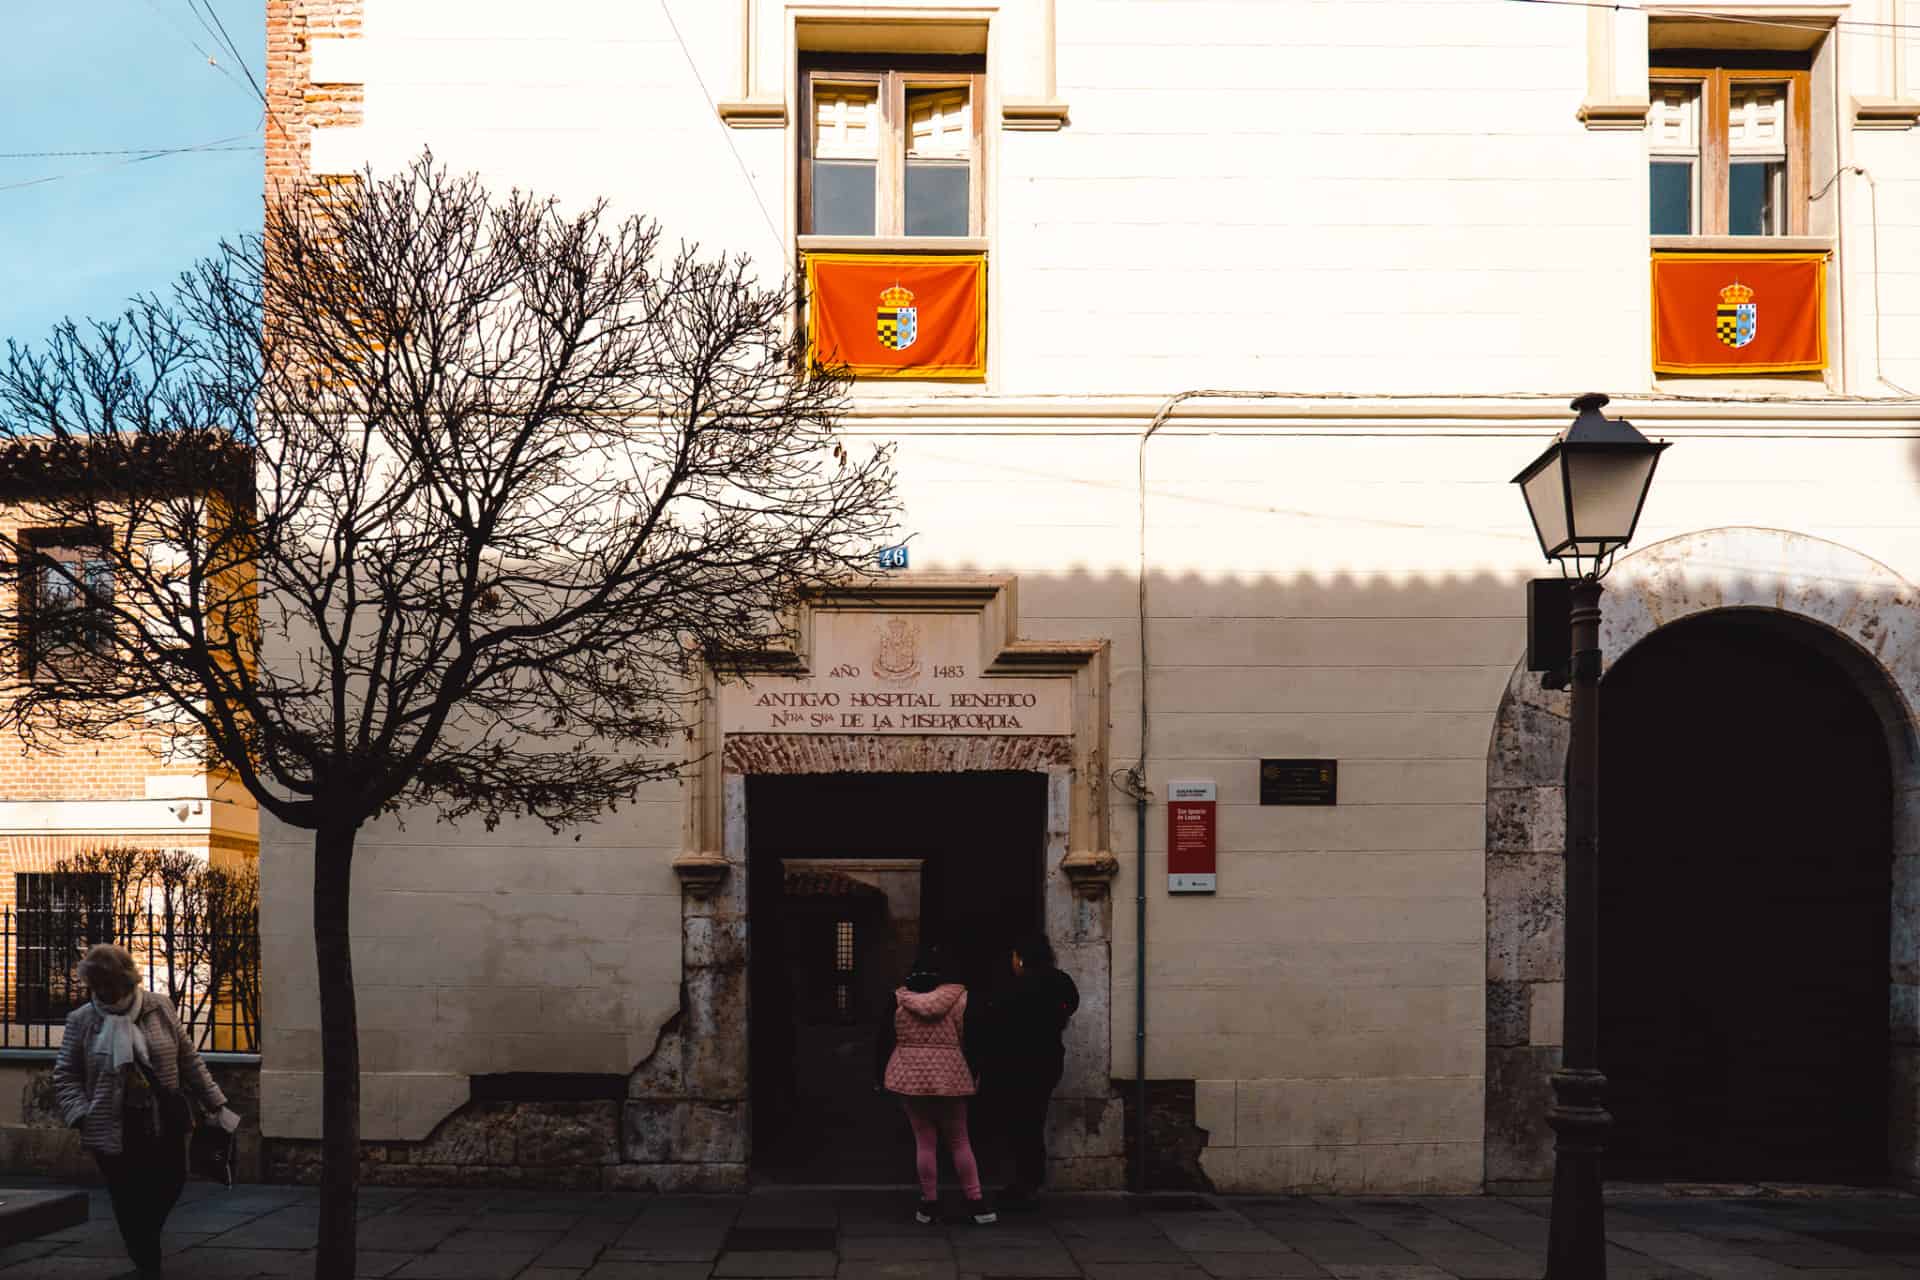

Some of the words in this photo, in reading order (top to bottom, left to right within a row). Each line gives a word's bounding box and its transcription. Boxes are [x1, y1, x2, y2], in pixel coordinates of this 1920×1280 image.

[882, 549, 905, 566] 46
[829, 664, 861, 678] AÑO
[932, 665, 965, 679] 1483
[753, 692, 841, 707] ANTIGVO
[850, 692, 941, 707] HOSPITAL
[950, 693, 1037, 708] BENEFICO
[840, 713, 865, 728] DE
[872, 713, 894, 731] LA
[901, 713, 1023, 731] MISERICORDIA
